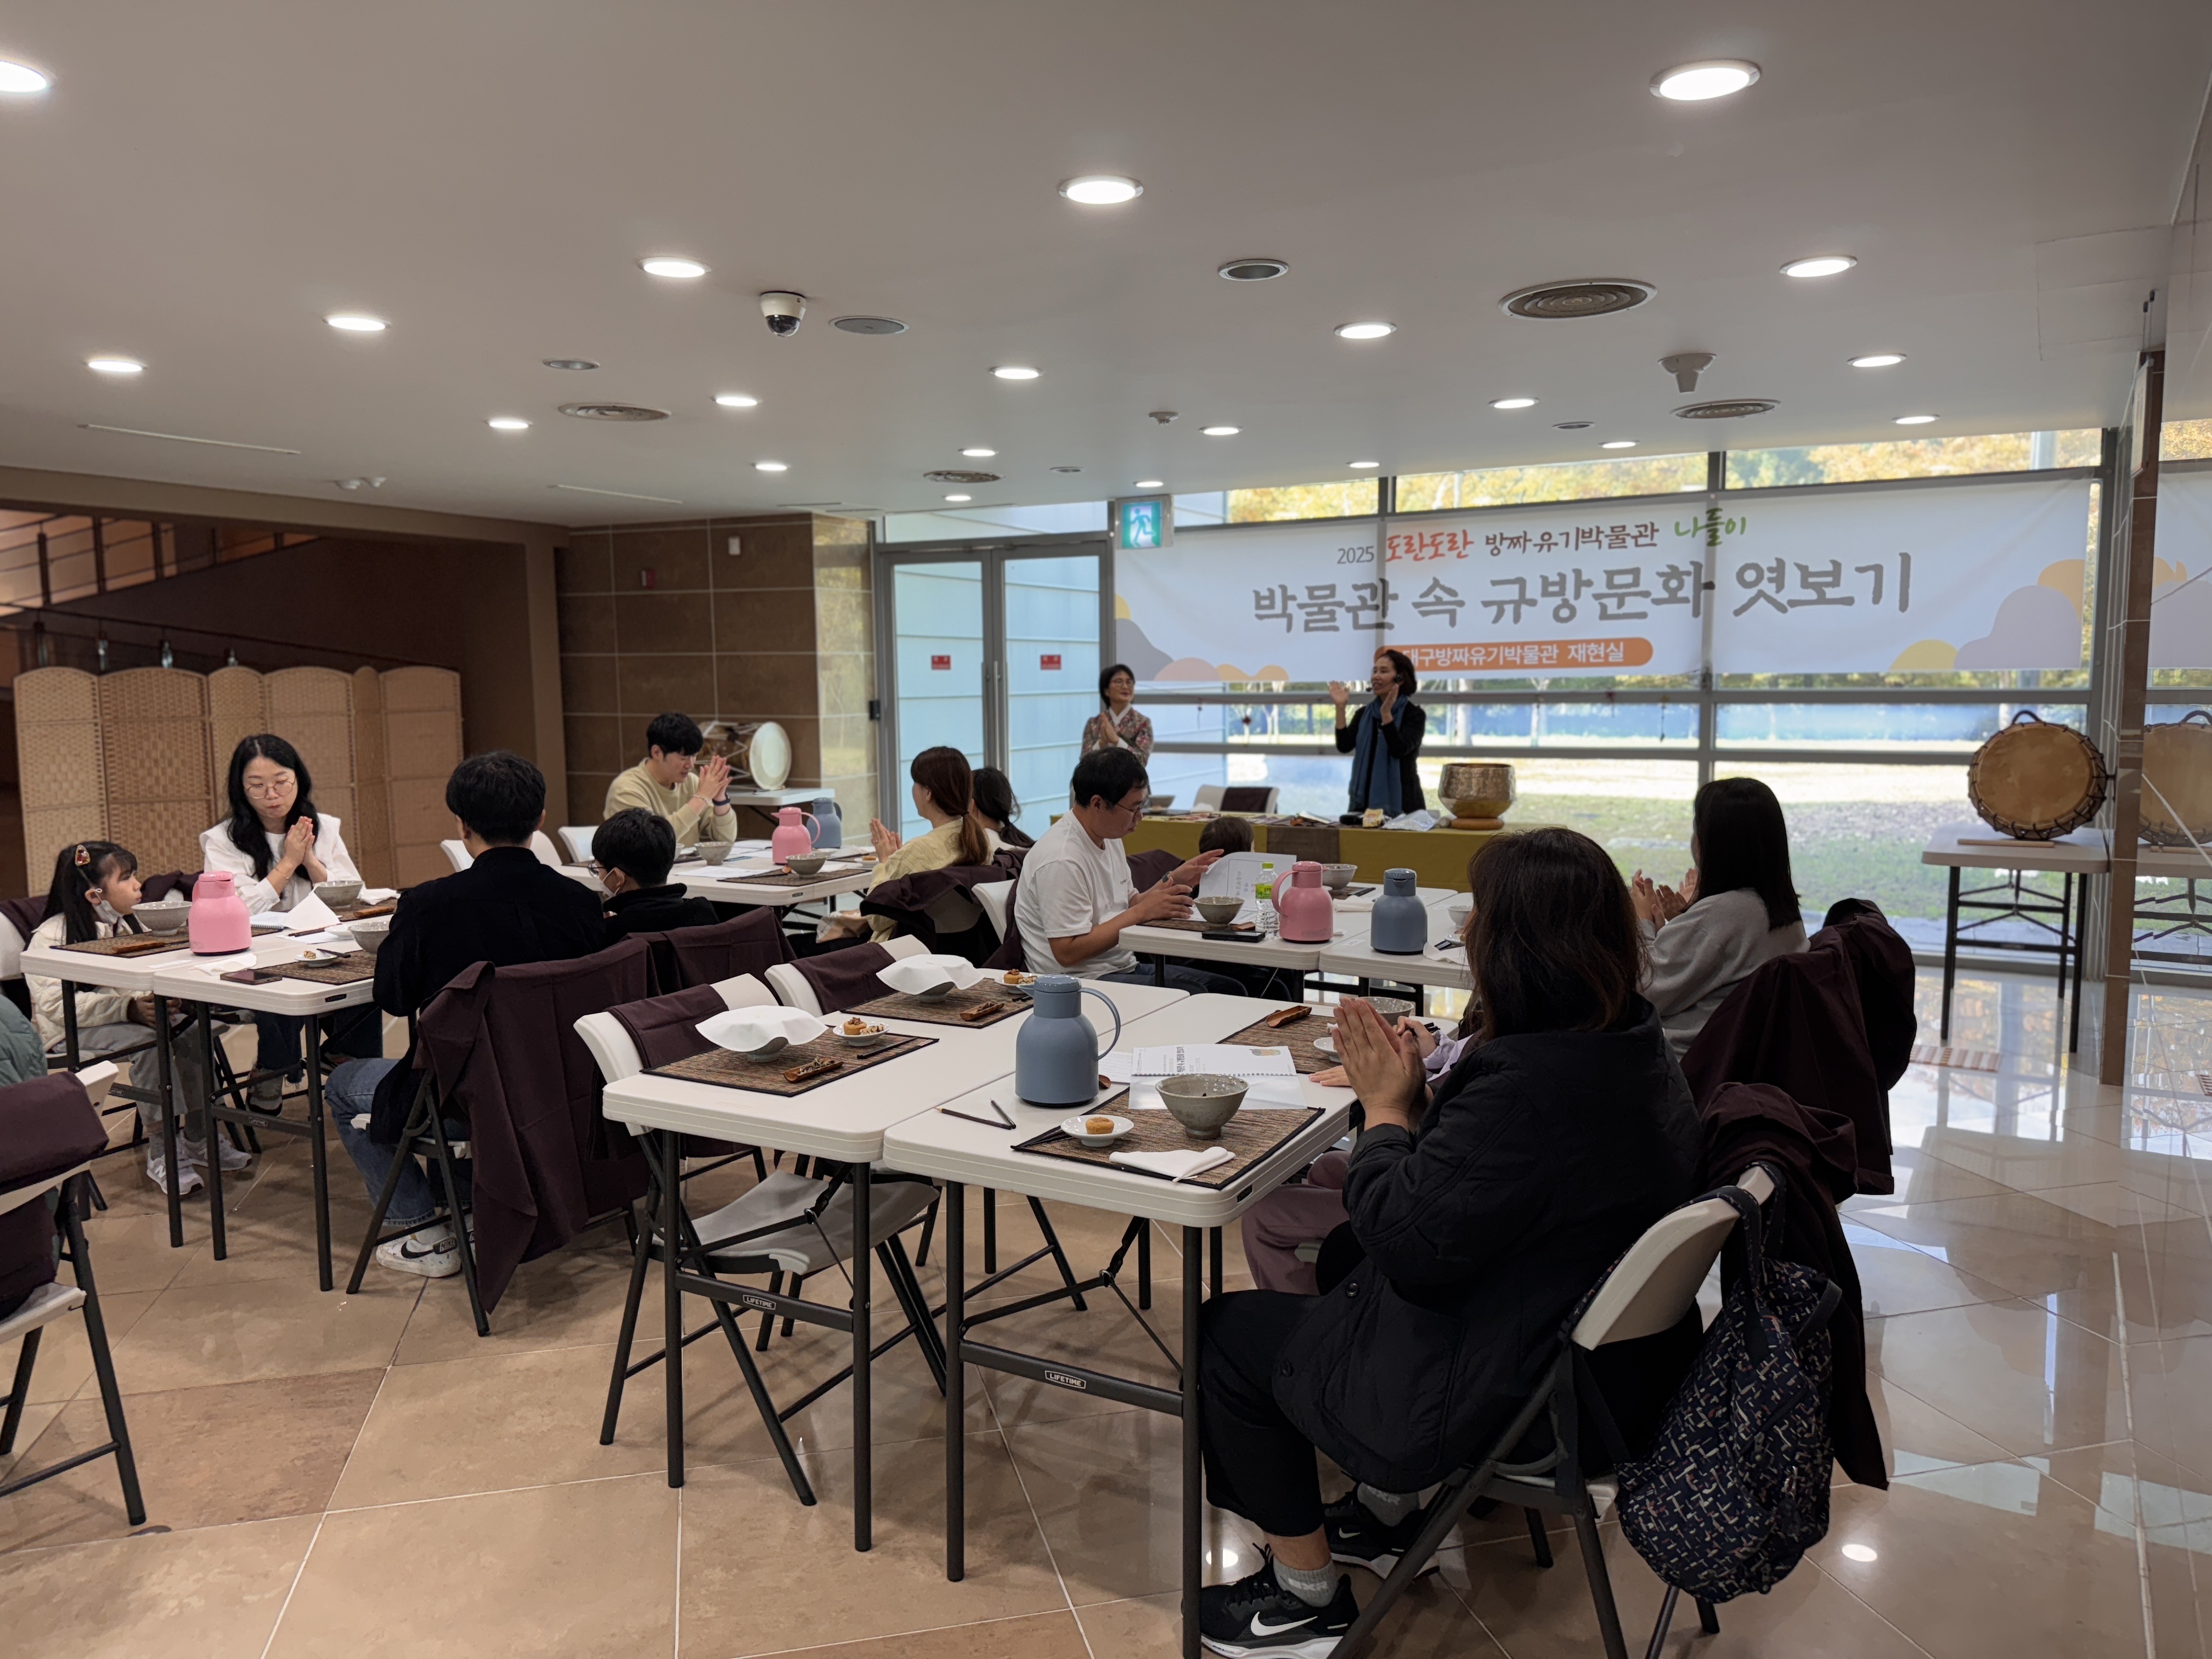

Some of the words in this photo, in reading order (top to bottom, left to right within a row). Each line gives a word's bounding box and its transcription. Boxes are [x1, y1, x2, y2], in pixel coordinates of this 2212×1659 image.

[1337, 545, 1374, 564] 2025
[1385, 529, 1474, 562] 도란도란
[1485, 522, 1660, 556] 방짜유기박물관
[1674, 508, 1747, 547] 나들이
[1252, 578, 1399, 633] 박물관
[1412, 577, 1466, 628] 속
[1481, 561, 1716, 624] 규방문화
[1733, 552, 1911, 617] 엿보기
[1567, 642, 1624, 663] 재현실
[747, 1297, 772, 1308] LIFETIME
[1049, 1373, 1081, 1386] LIFETIME
